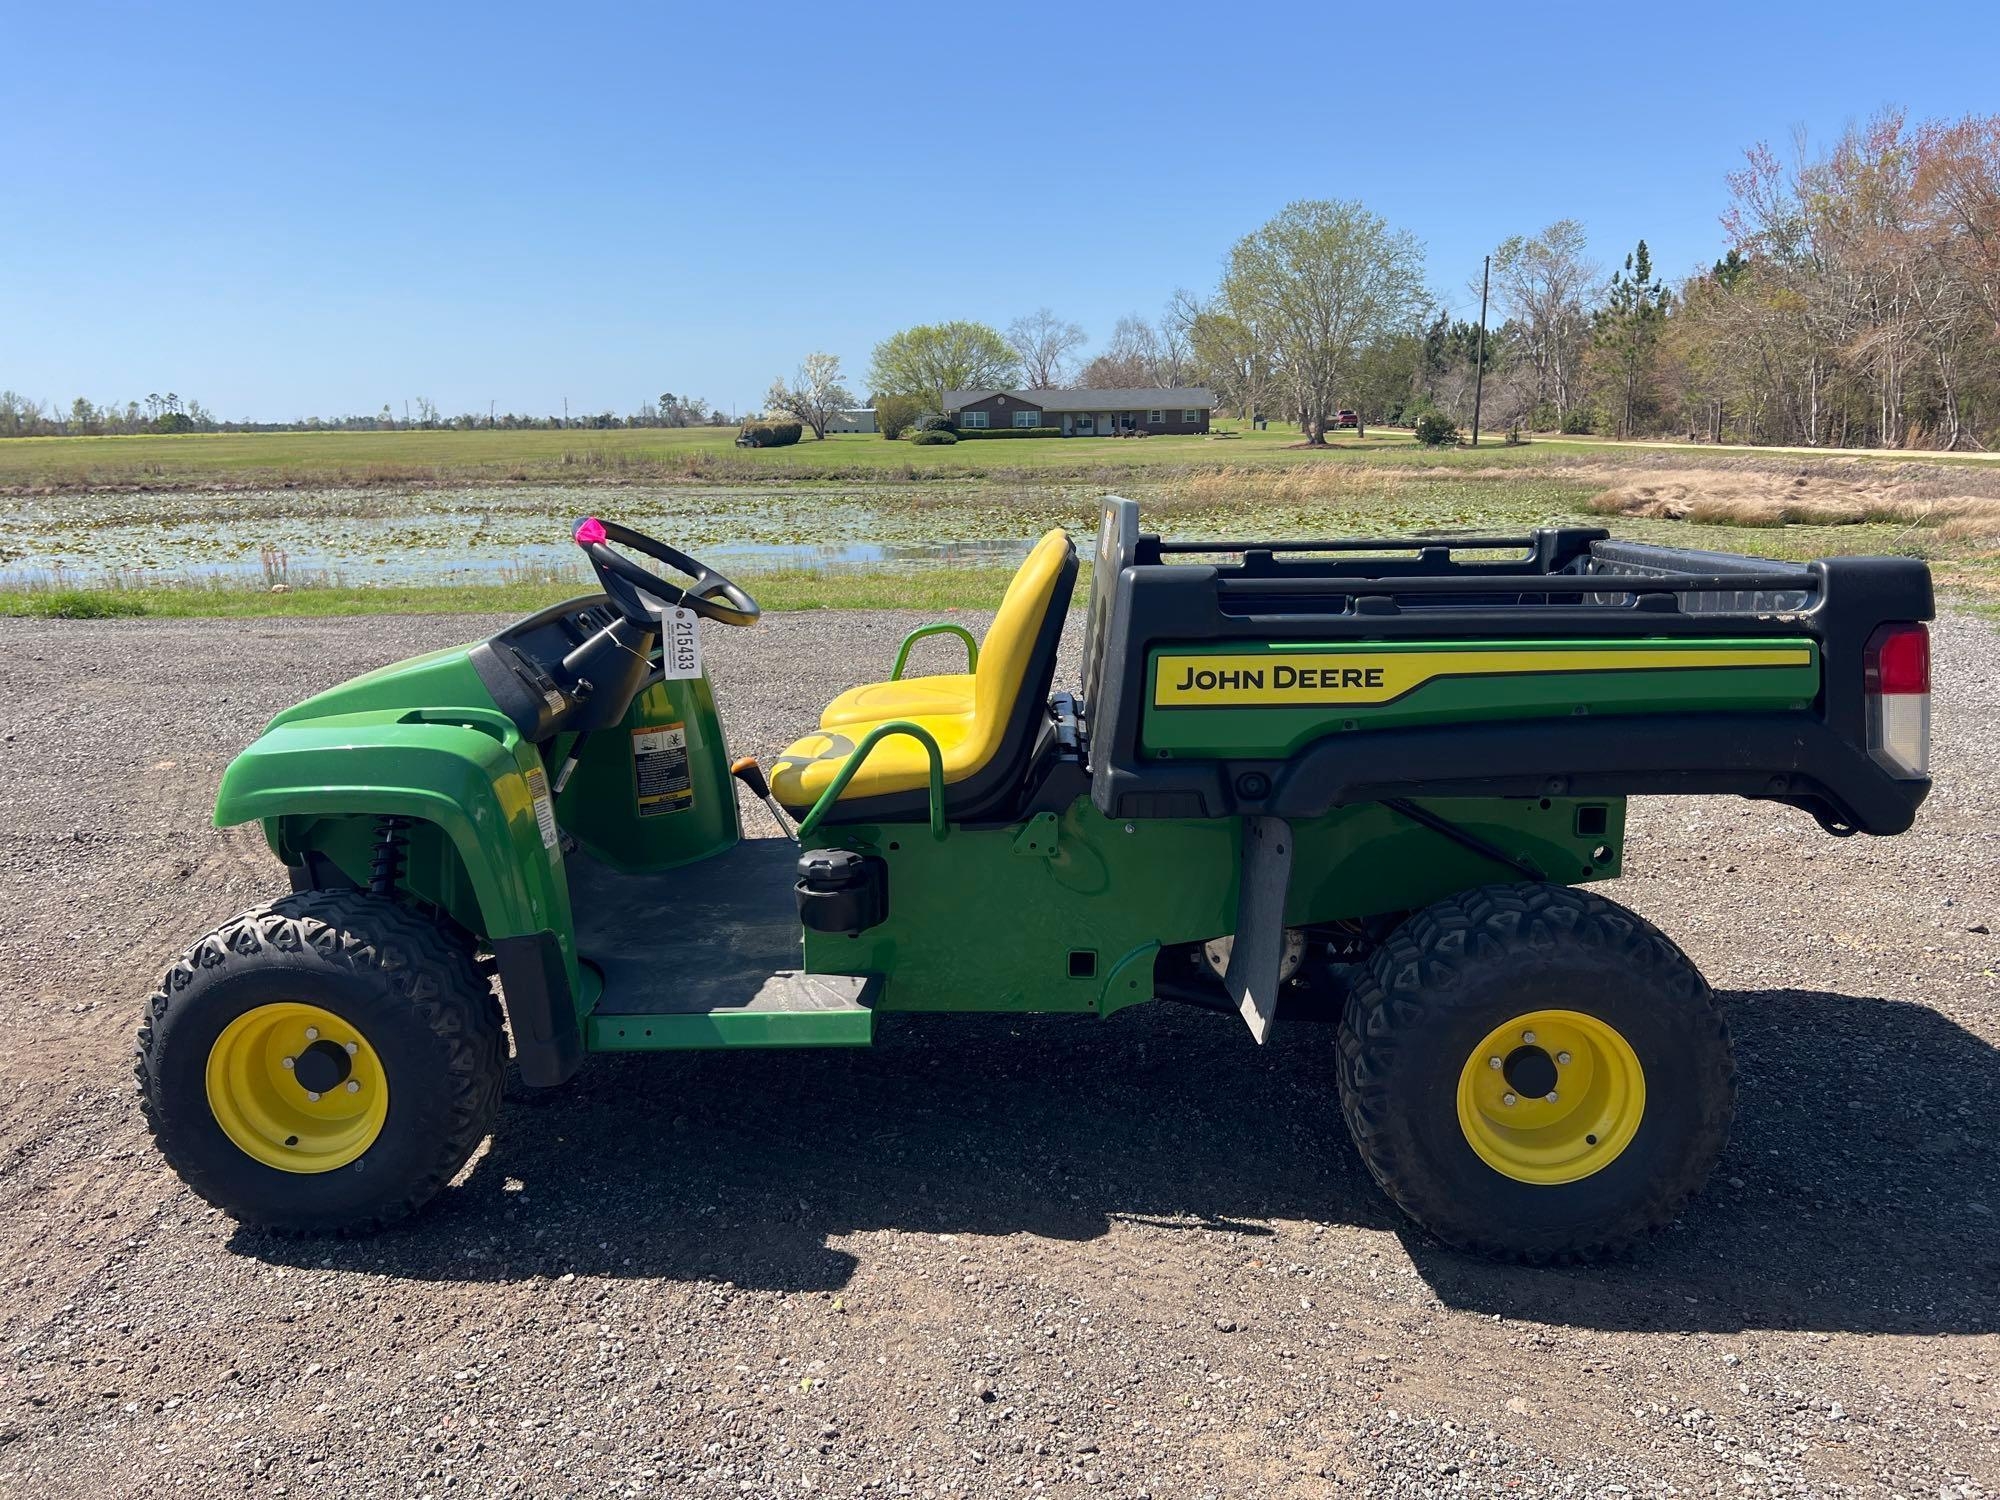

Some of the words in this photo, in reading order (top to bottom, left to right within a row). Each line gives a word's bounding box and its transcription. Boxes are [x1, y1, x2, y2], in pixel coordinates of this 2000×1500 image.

[676, 622, 695, 670] 215433
[1176, 667, 1264, 690] JOHN
[1273, 665, 1384, 689] DEERE
